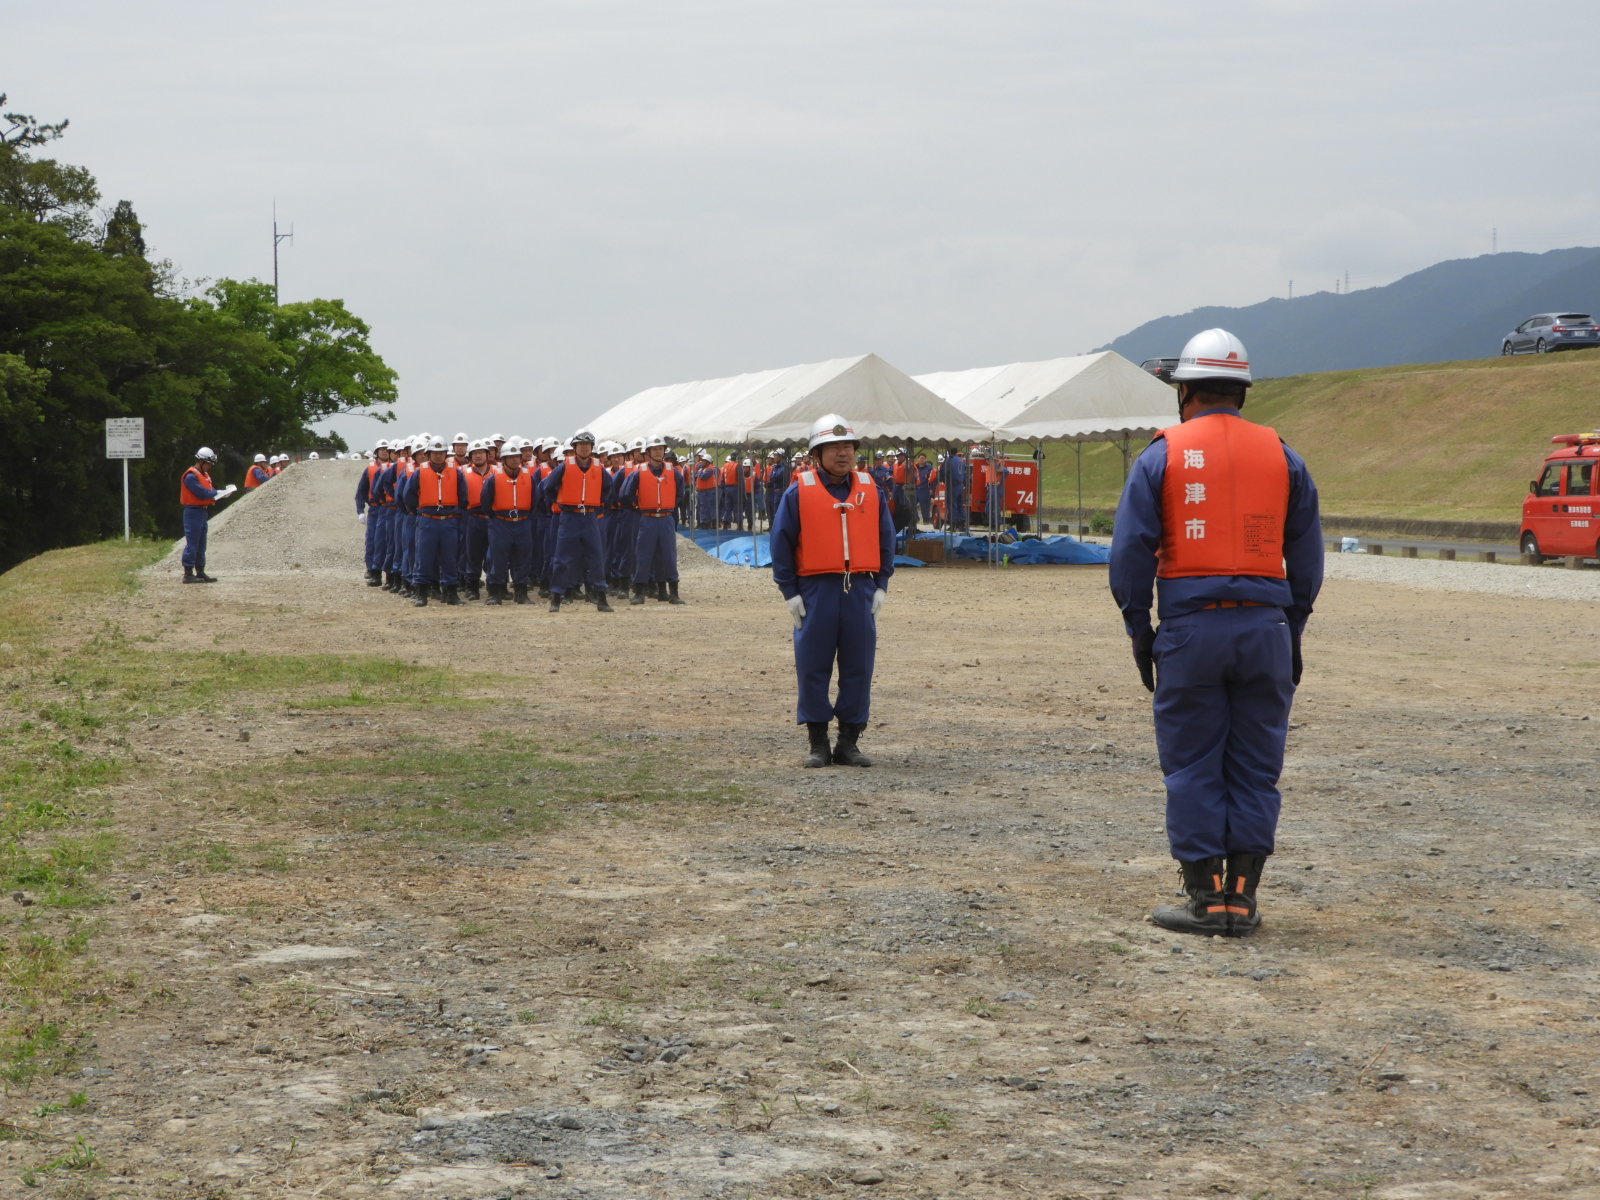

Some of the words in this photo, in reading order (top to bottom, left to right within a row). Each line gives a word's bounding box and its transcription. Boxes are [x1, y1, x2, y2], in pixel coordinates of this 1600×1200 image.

[1016, 490, 1034, 505] 74
[1184, 449, 1206, 540] 海津市
